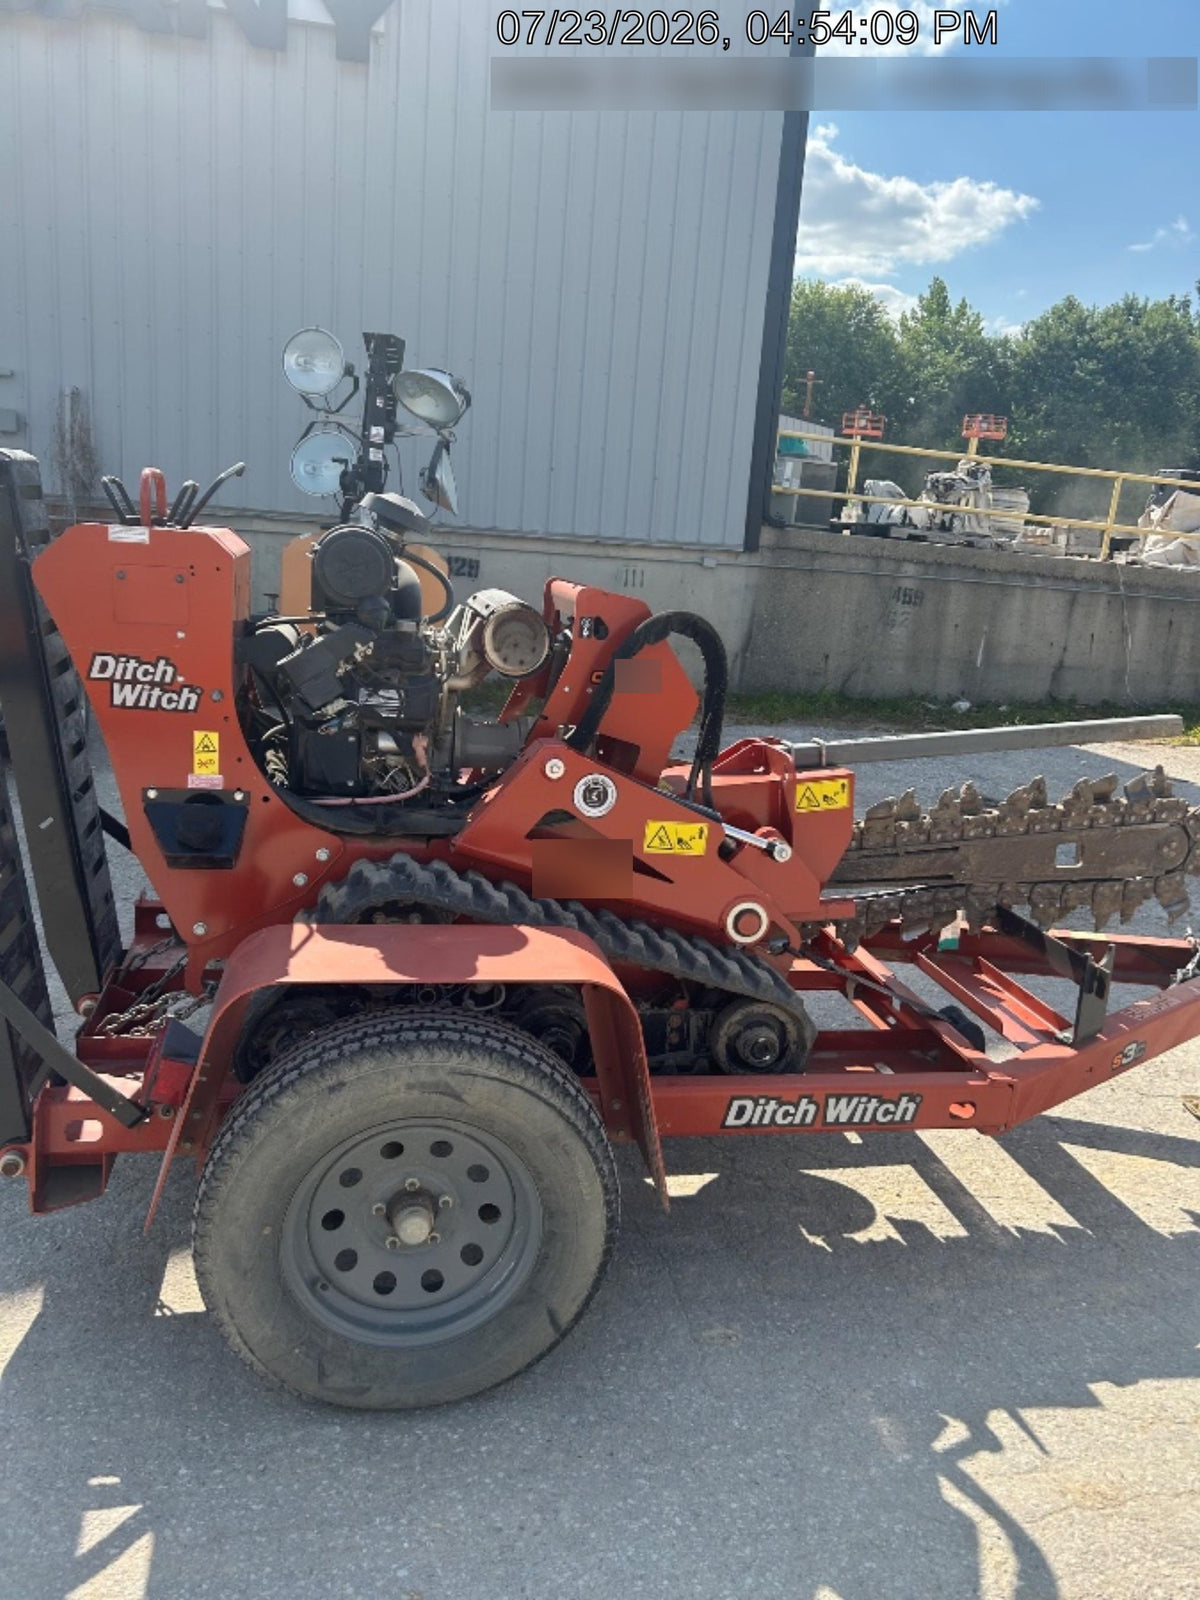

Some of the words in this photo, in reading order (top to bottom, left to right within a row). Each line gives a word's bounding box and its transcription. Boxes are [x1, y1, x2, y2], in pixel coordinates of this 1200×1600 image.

[89, 655, 175, 683] Ditch
[112, 682, 201, 711] Witch
[725, 1098, 817, 1126] Ditch
[826, 1096, 920, 1123] Witch
